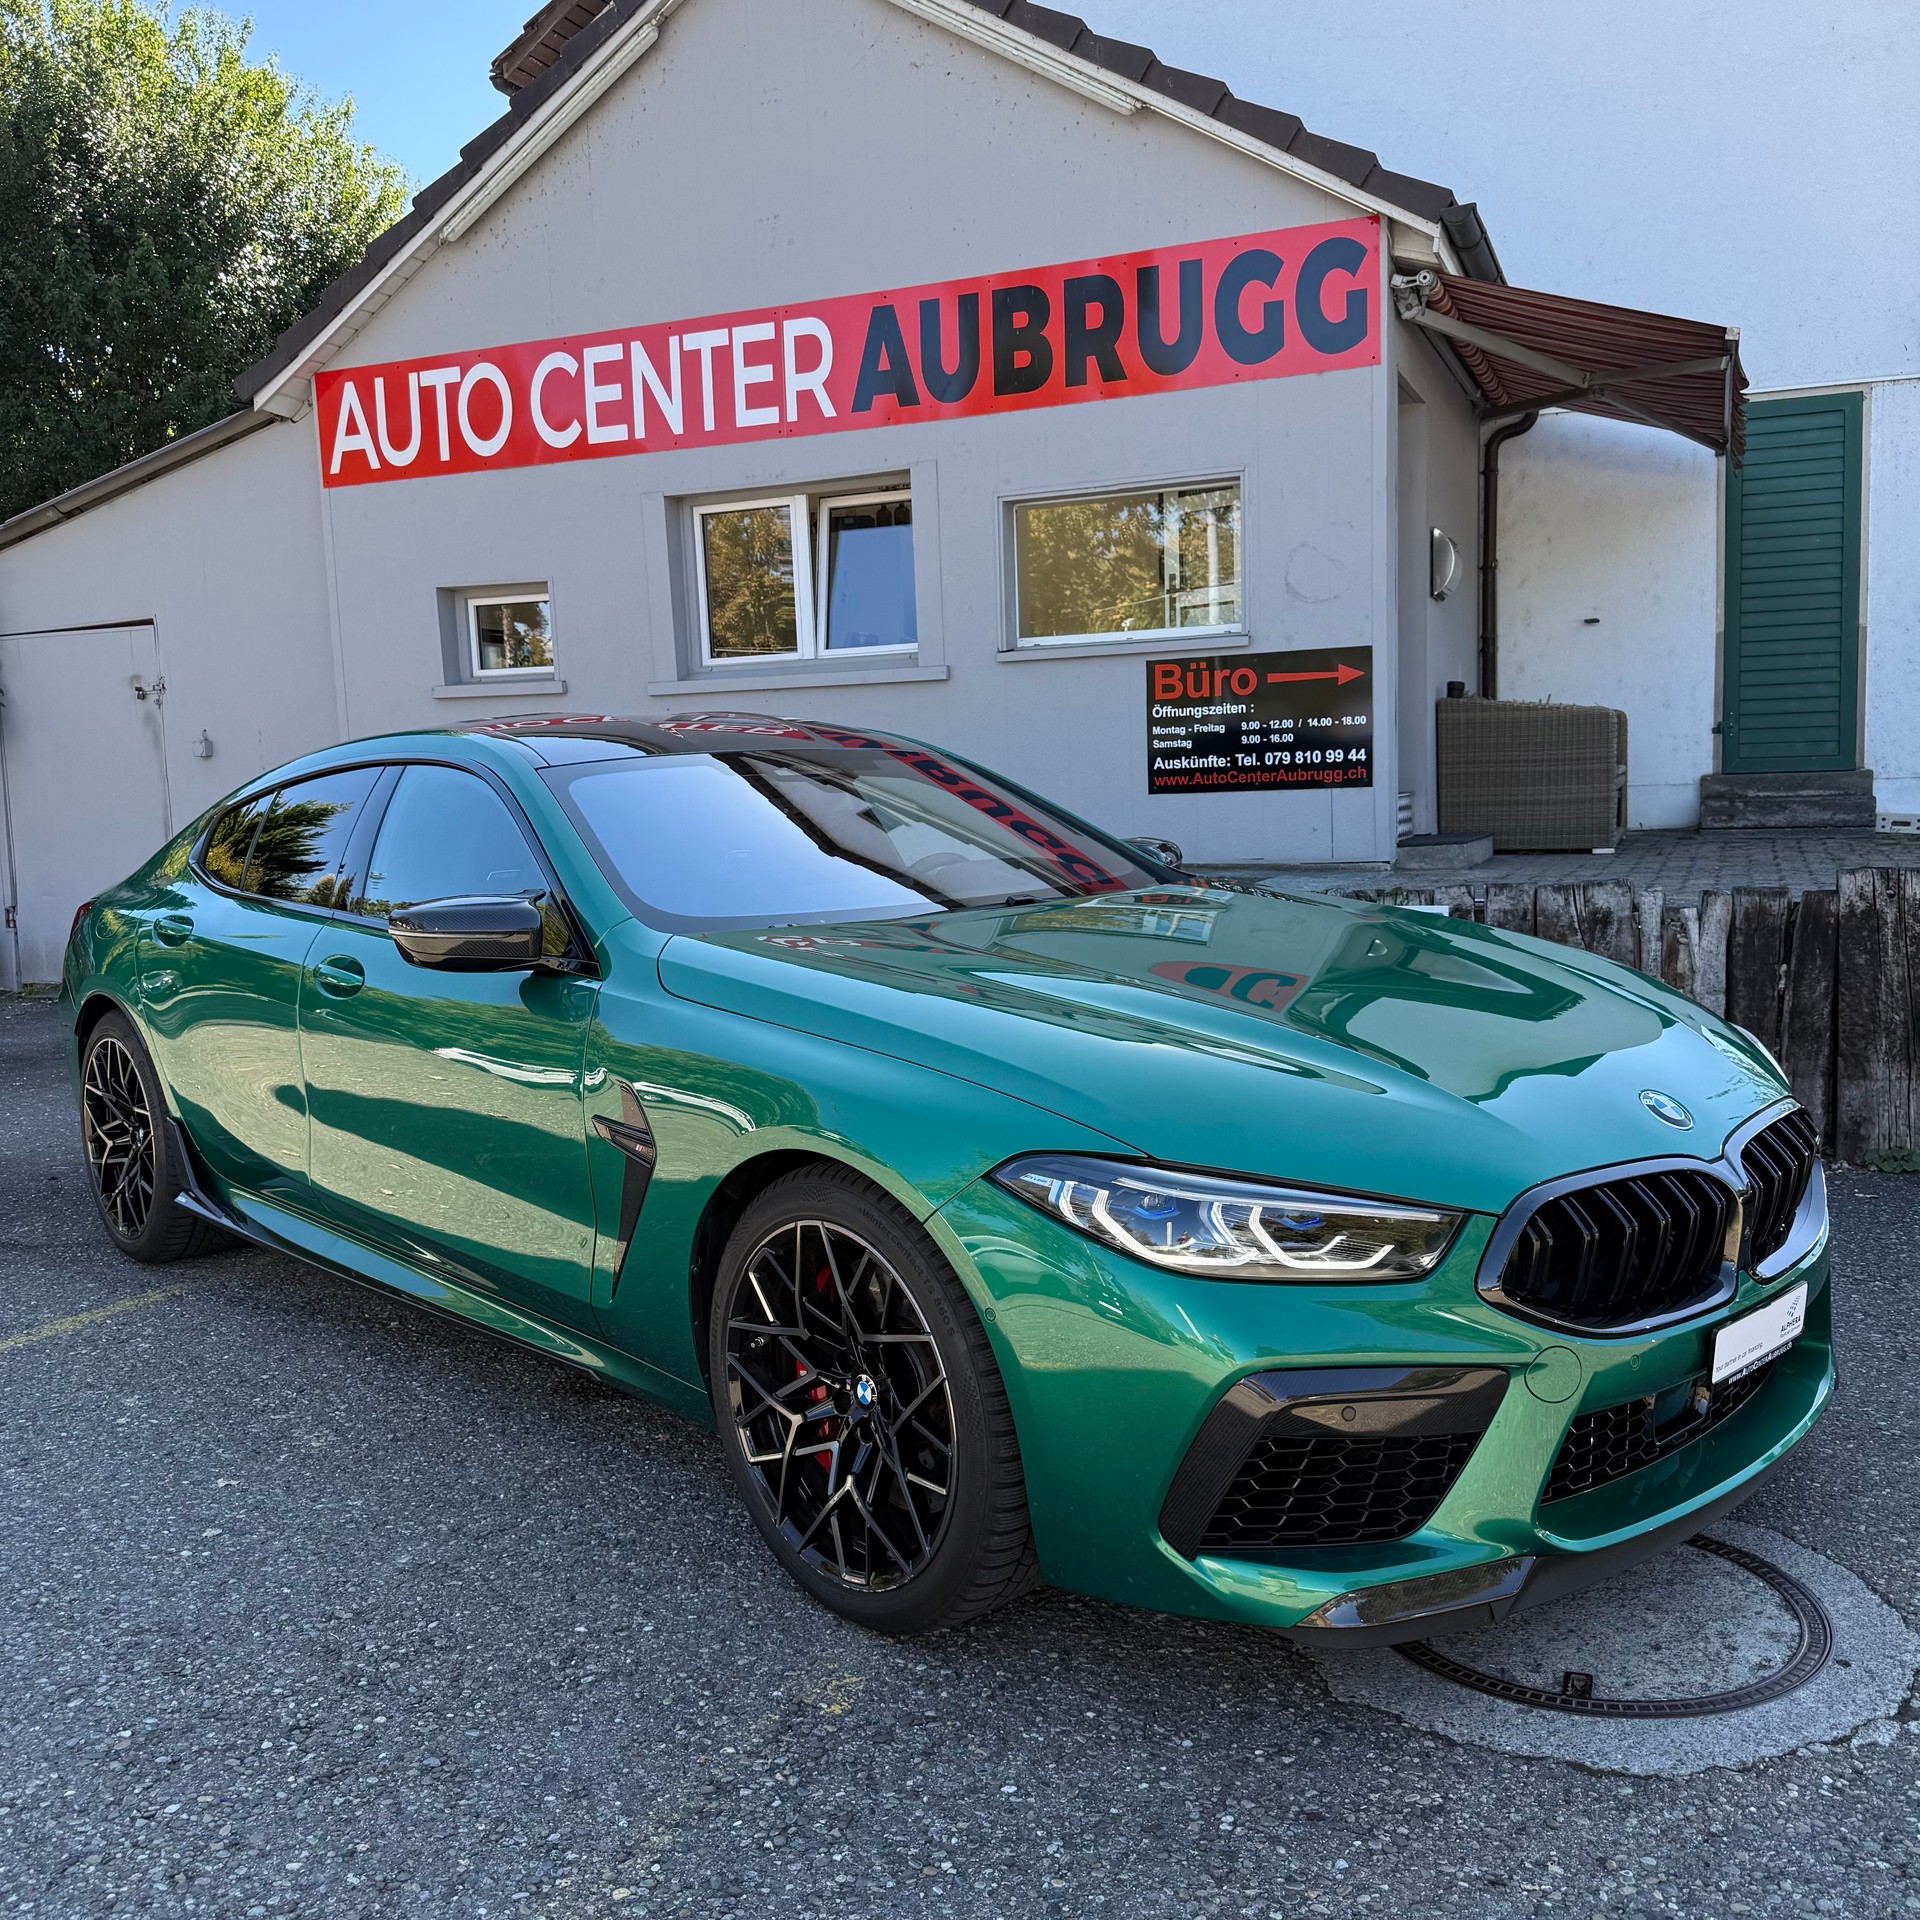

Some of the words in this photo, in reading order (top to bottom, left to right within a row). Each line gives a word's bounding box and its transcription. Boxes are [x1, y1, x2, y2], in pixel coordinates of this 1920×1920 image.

[329, 362, 513, 475] AUTO
[530, 316, 838, 449] CENTER
[851, 237, 1369, 414] AUBRUGG
[1154, 661, 1258, 700] Büro
[1152, 702, 1247, 719] Öffnungszeiten
[1152, 725, 1186, 736] Montag
[1193, 723, 1226, 734] Freitag
[1241, 721, 1260, 731] 9.00
[1269, 719, 1294, 729] 12.00
[1307, 717, 1333, 727] 14.00
[1341, 715, 1367, 725] 18.00
[1152, 738, 1193, 750] Samstag
[1241, 735, 1261, 745] 9.00
[1269, 733, 1294, 743] 16.00
[1153, 755, 1231, 770] Auskünfte:
[1234, 752, 1261, 767] Tel.
[1264, 751, 1291, 766] 079
[1294, 750, 1322, 764] 810
[1325, 749, 1344, 763] 99
[1347, 748, 1367, 762] 44
[1154, 766, 1368, 787] www.AutoCenterAubrugg.ch
[923, 1276, 936, 1296] TS
[934, 1297, 952, 1326] 860
